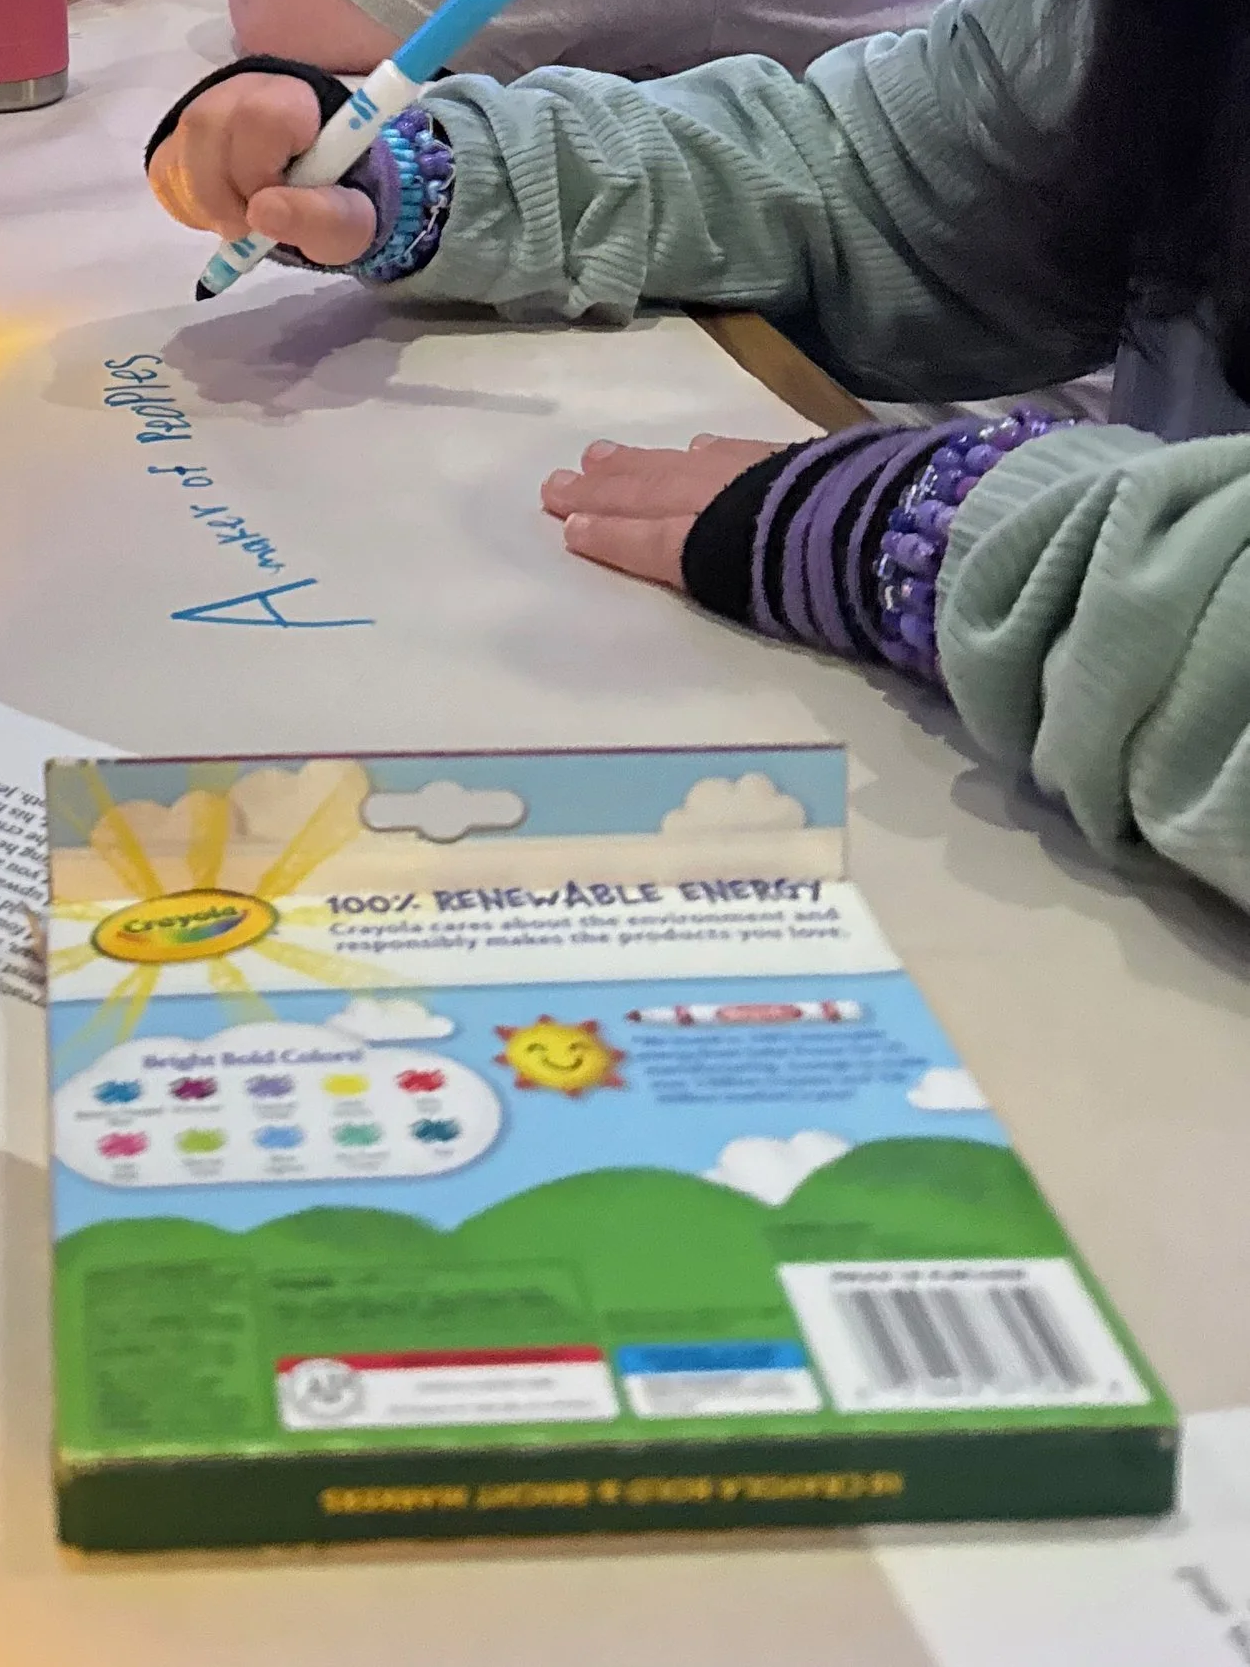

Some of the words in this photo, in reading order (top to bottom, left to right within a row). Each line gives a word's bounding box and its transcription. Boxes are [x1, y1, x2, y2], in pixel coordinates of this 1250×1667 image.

[147, 465, 214, 488] of
[170, 578, 377, 628] A
[8, 807, 36, 824] his
[5, 862, 43, 880] you
[325, 892, 421, 916] 100%
[433, 880, 664, 913] RENEWABLE
[679, 878, 823, 905] ENERGY
[123, 904, 240, 934] Crayola
